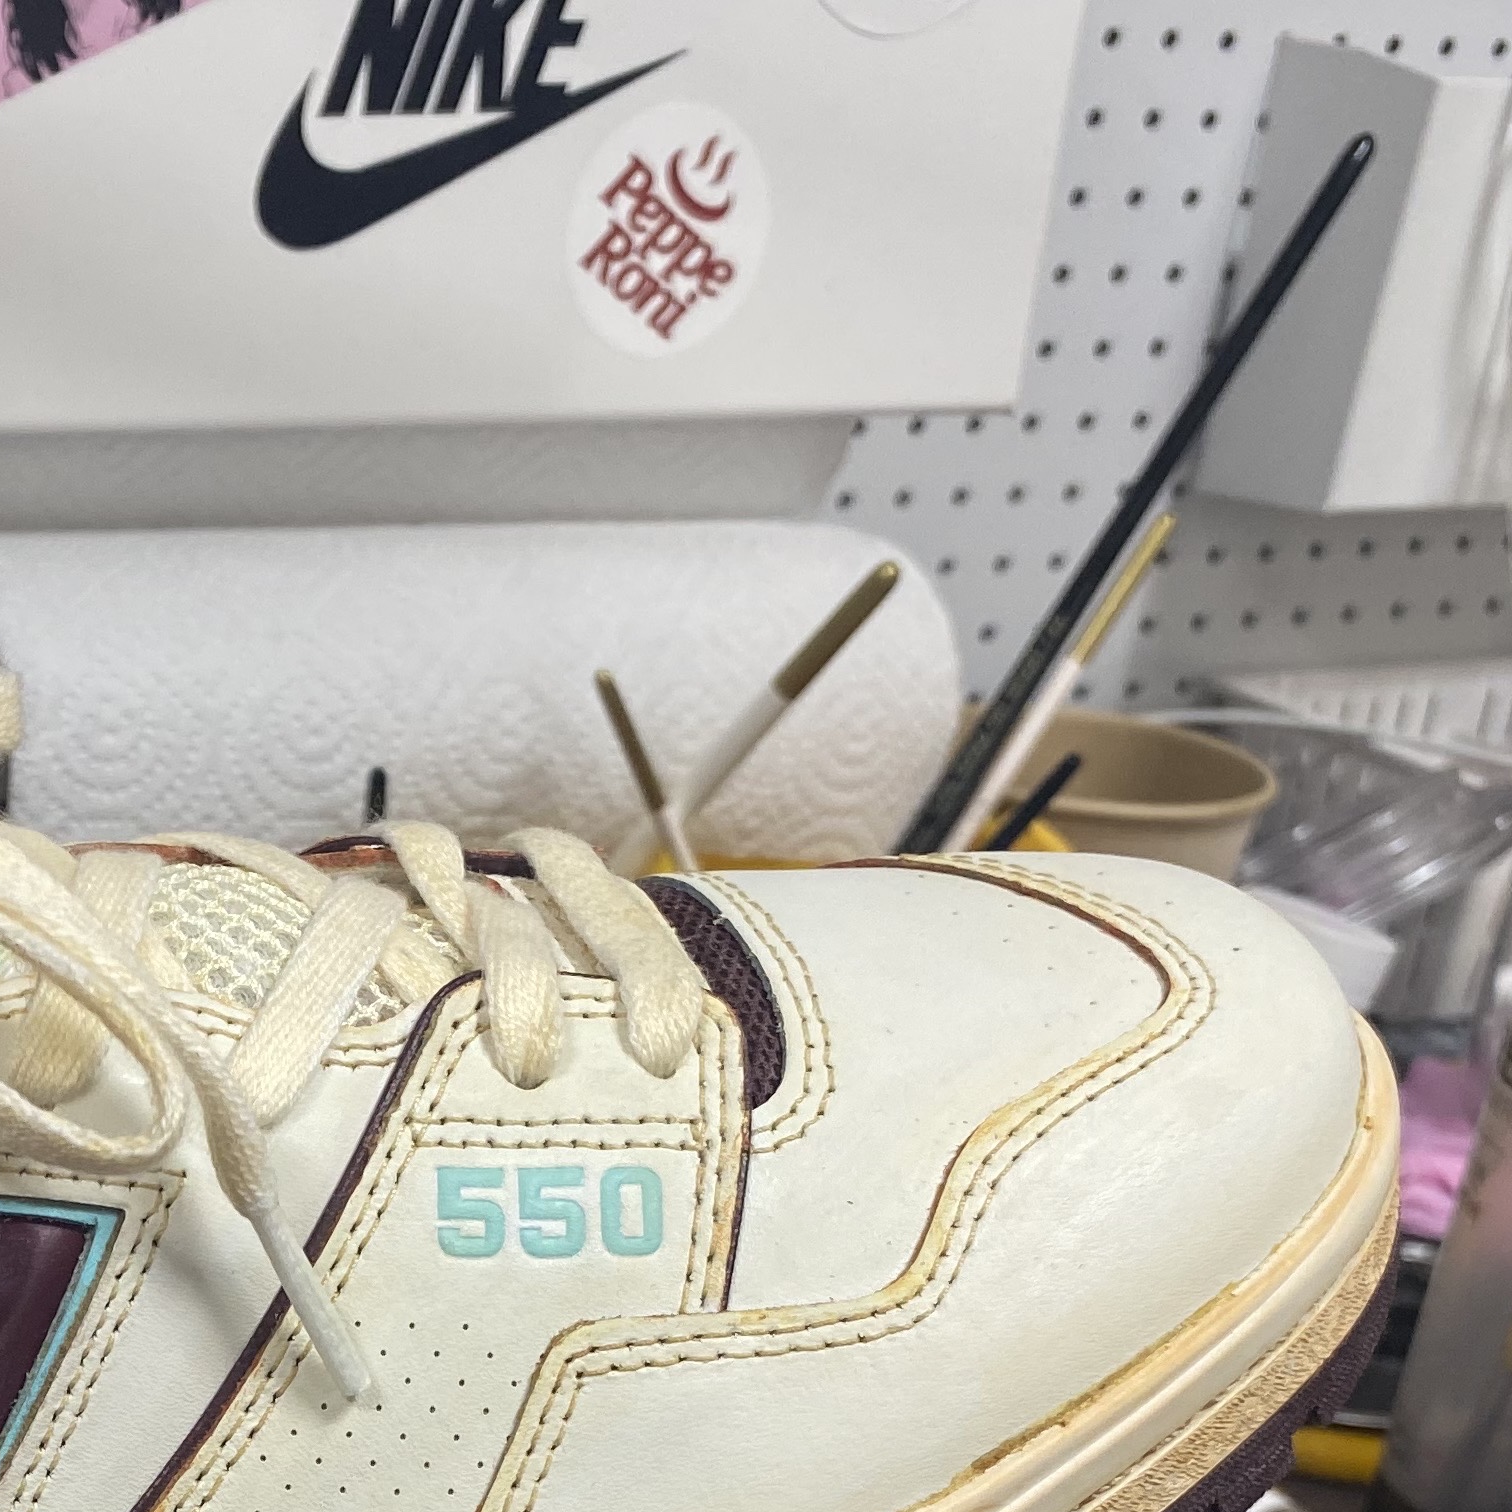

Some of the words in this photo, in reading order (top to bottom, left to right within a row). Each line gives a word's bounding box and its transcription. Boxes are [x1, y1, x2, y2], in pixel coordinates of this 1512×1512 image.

[316, 0, 586, 116] NIKE
[578, 219, 698, 340] Roni
[599, 152, 735, 297] Peppe
[436, 1165, 665, 1259] 550
